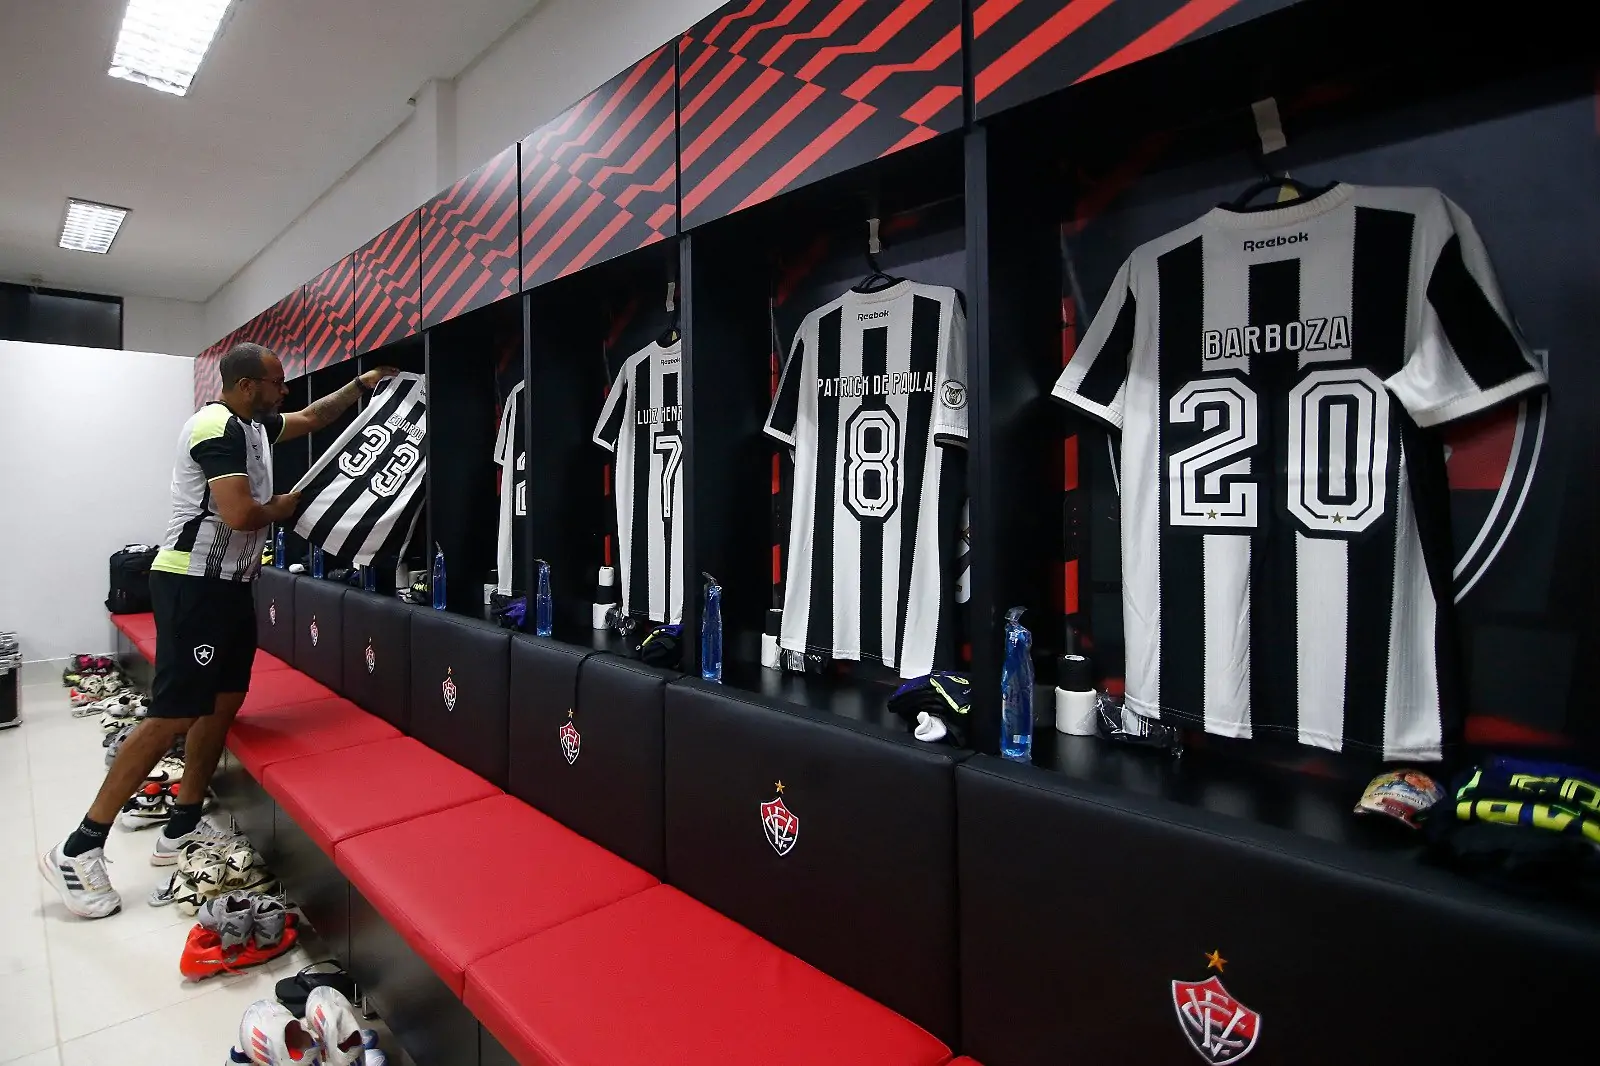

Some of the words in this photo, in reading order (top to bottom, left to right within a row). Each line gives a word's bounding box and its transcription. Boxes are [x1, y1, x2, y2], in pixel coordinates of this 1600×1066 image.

[1243, 232, 1309, 252] Reebok
[857, 309, 890, 322] Reebok
[1203, 315, 1352, 361] BARBOZA
[817, 375, 869, 398] PATRICK
[873, 373, 890, 396] DE
[892, 371, 934, 396] PAULA
[637, 406, 659, 425] LUIZ
[338, 424, 420, 498] 33
[846, 408, 898, 519] 8
[1168, 367, 1390, 532] 20
[654, 433, 683, 519] 7
